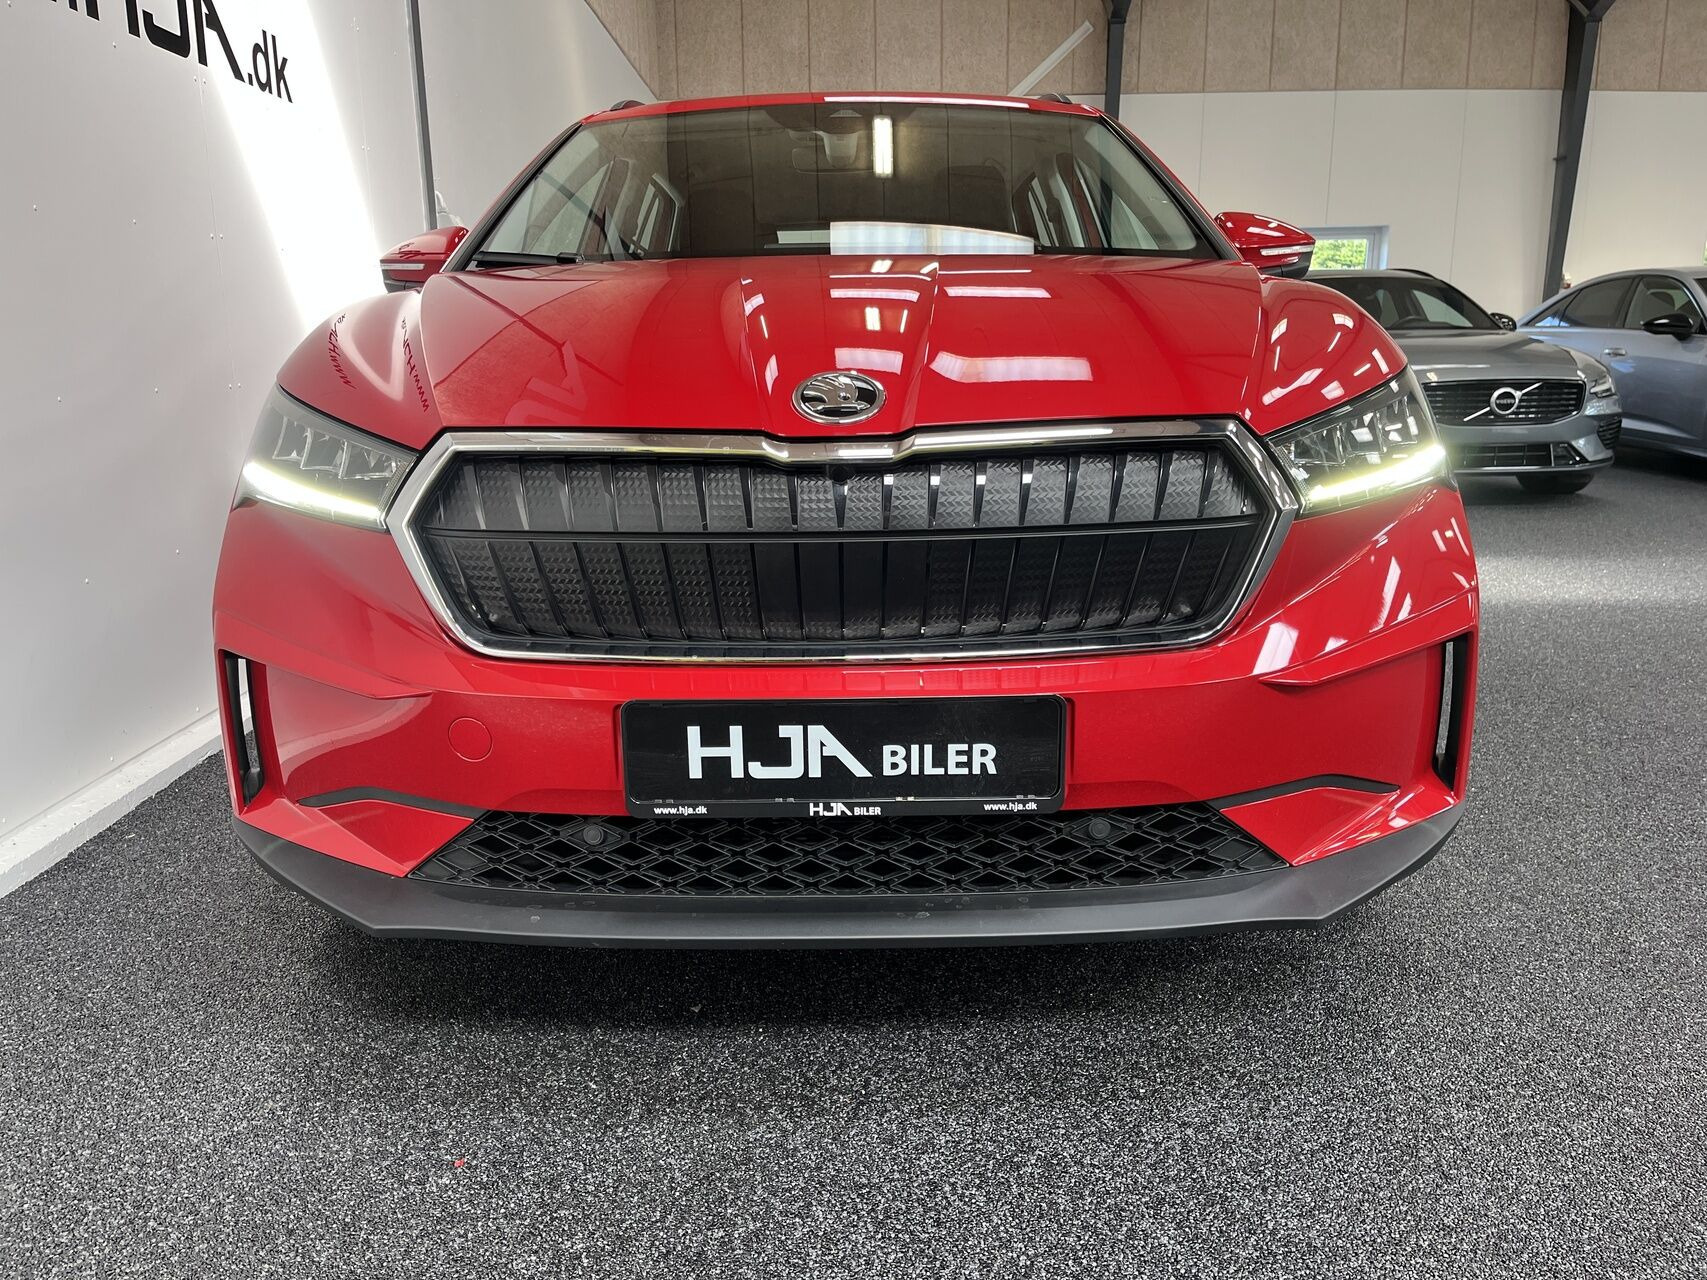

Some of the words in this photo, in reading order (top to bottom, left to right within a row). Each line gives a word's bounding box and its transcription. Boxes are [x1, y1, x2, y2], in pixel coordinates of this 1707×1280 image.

[687, 725, 873, 779] HJA
[882, 743, 997, 776] BILER
[653, 806, 708, 816] www.hja.dk
[809, 802, 853, 816] HJA
[853, 807, 882, 816] BILER
[983, 801, 1038, 812] www.hja.dk
